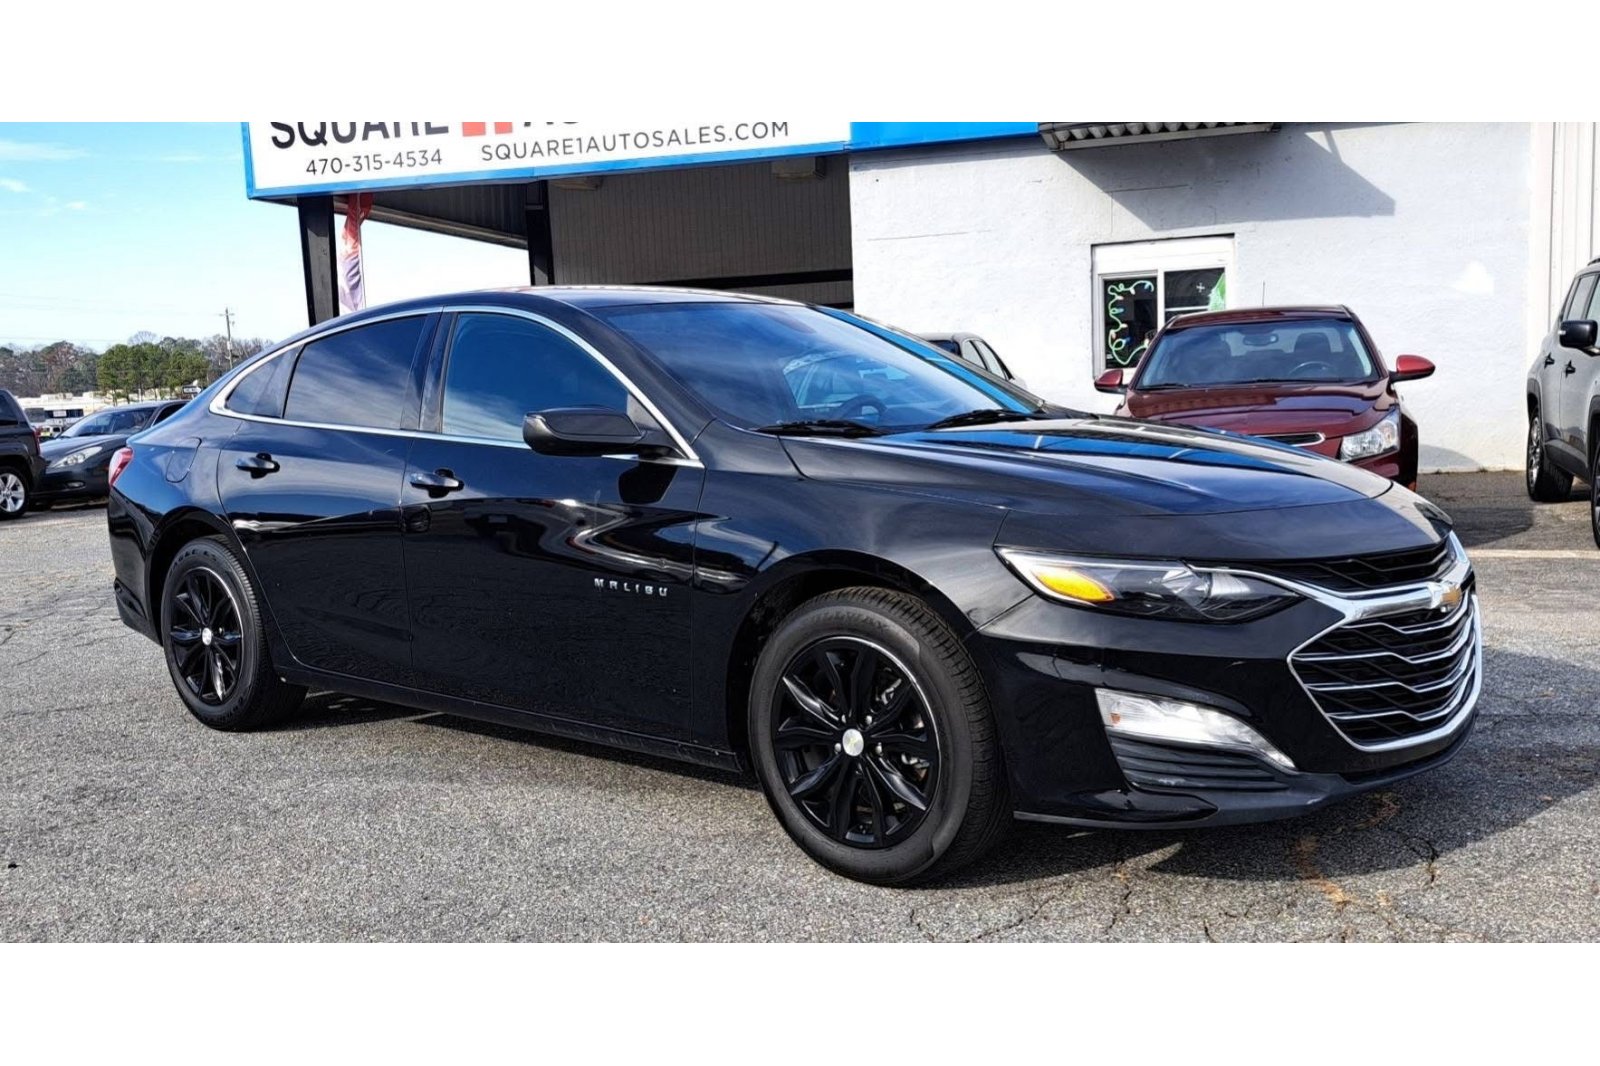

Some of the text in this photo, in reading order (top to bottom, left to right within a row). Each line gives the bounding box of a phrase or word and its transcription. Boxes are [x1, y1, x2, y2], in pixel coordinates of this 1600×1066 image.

[481, 121, 788, 161] SQUARE1AUTOSALES.COM
[306, 148, 442, 176] 470-315-4534
[594, 578, 667, 596] MALIBU
